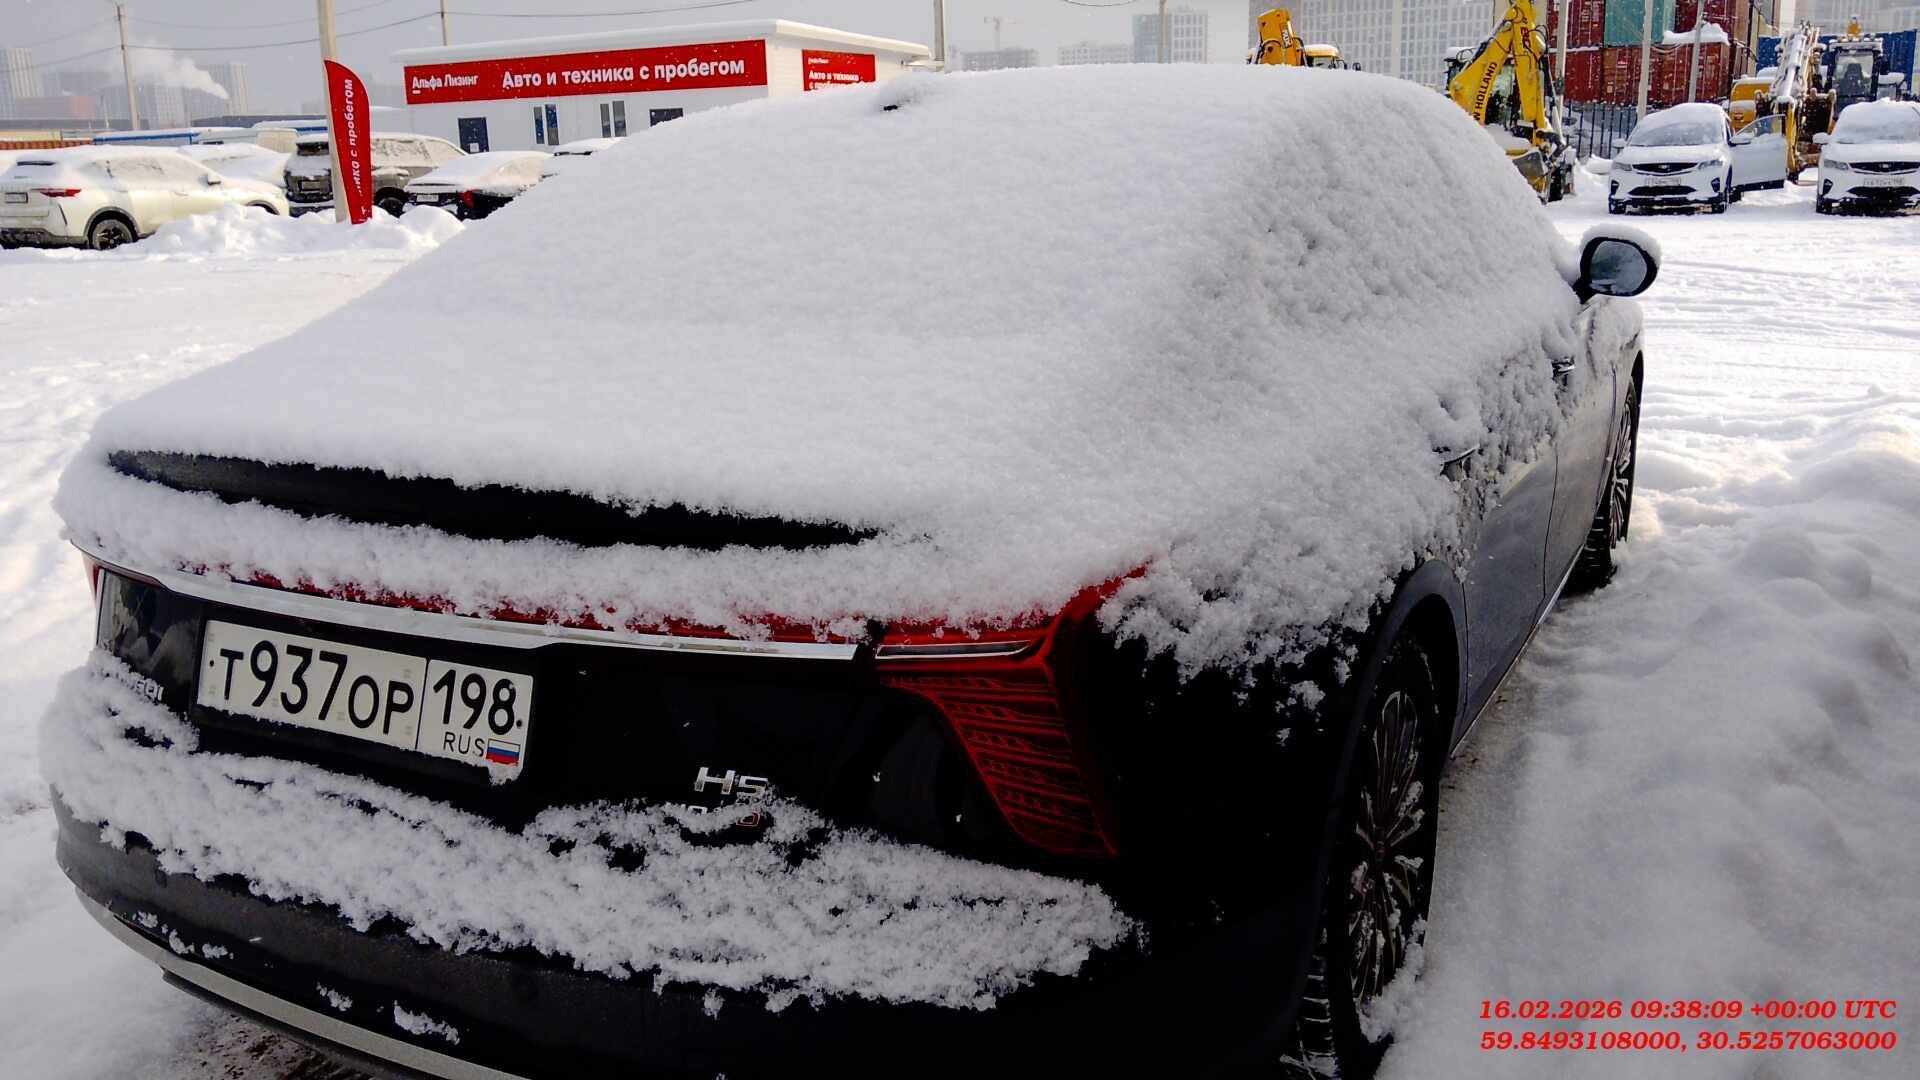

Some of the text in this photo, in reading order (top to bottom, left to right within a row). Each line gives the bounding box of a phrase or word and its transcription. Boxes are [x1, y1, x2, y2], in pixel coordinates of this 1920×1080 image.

[412, 74, 479, 91] Альфа Лизинг
[502, 57, 745, 89] Авто и техника с пробегом
[1474, 61, 1498, 110] HOLLAND
[344, 79, 358, 147] пробегом
[350, 149, 358, 158] с
[219, 640, 415, 735] Т937ОР
[433, 669, 517, 736] 198
[443, 731, 486, 758] RUS
[694, 766, 769, 802] H5
